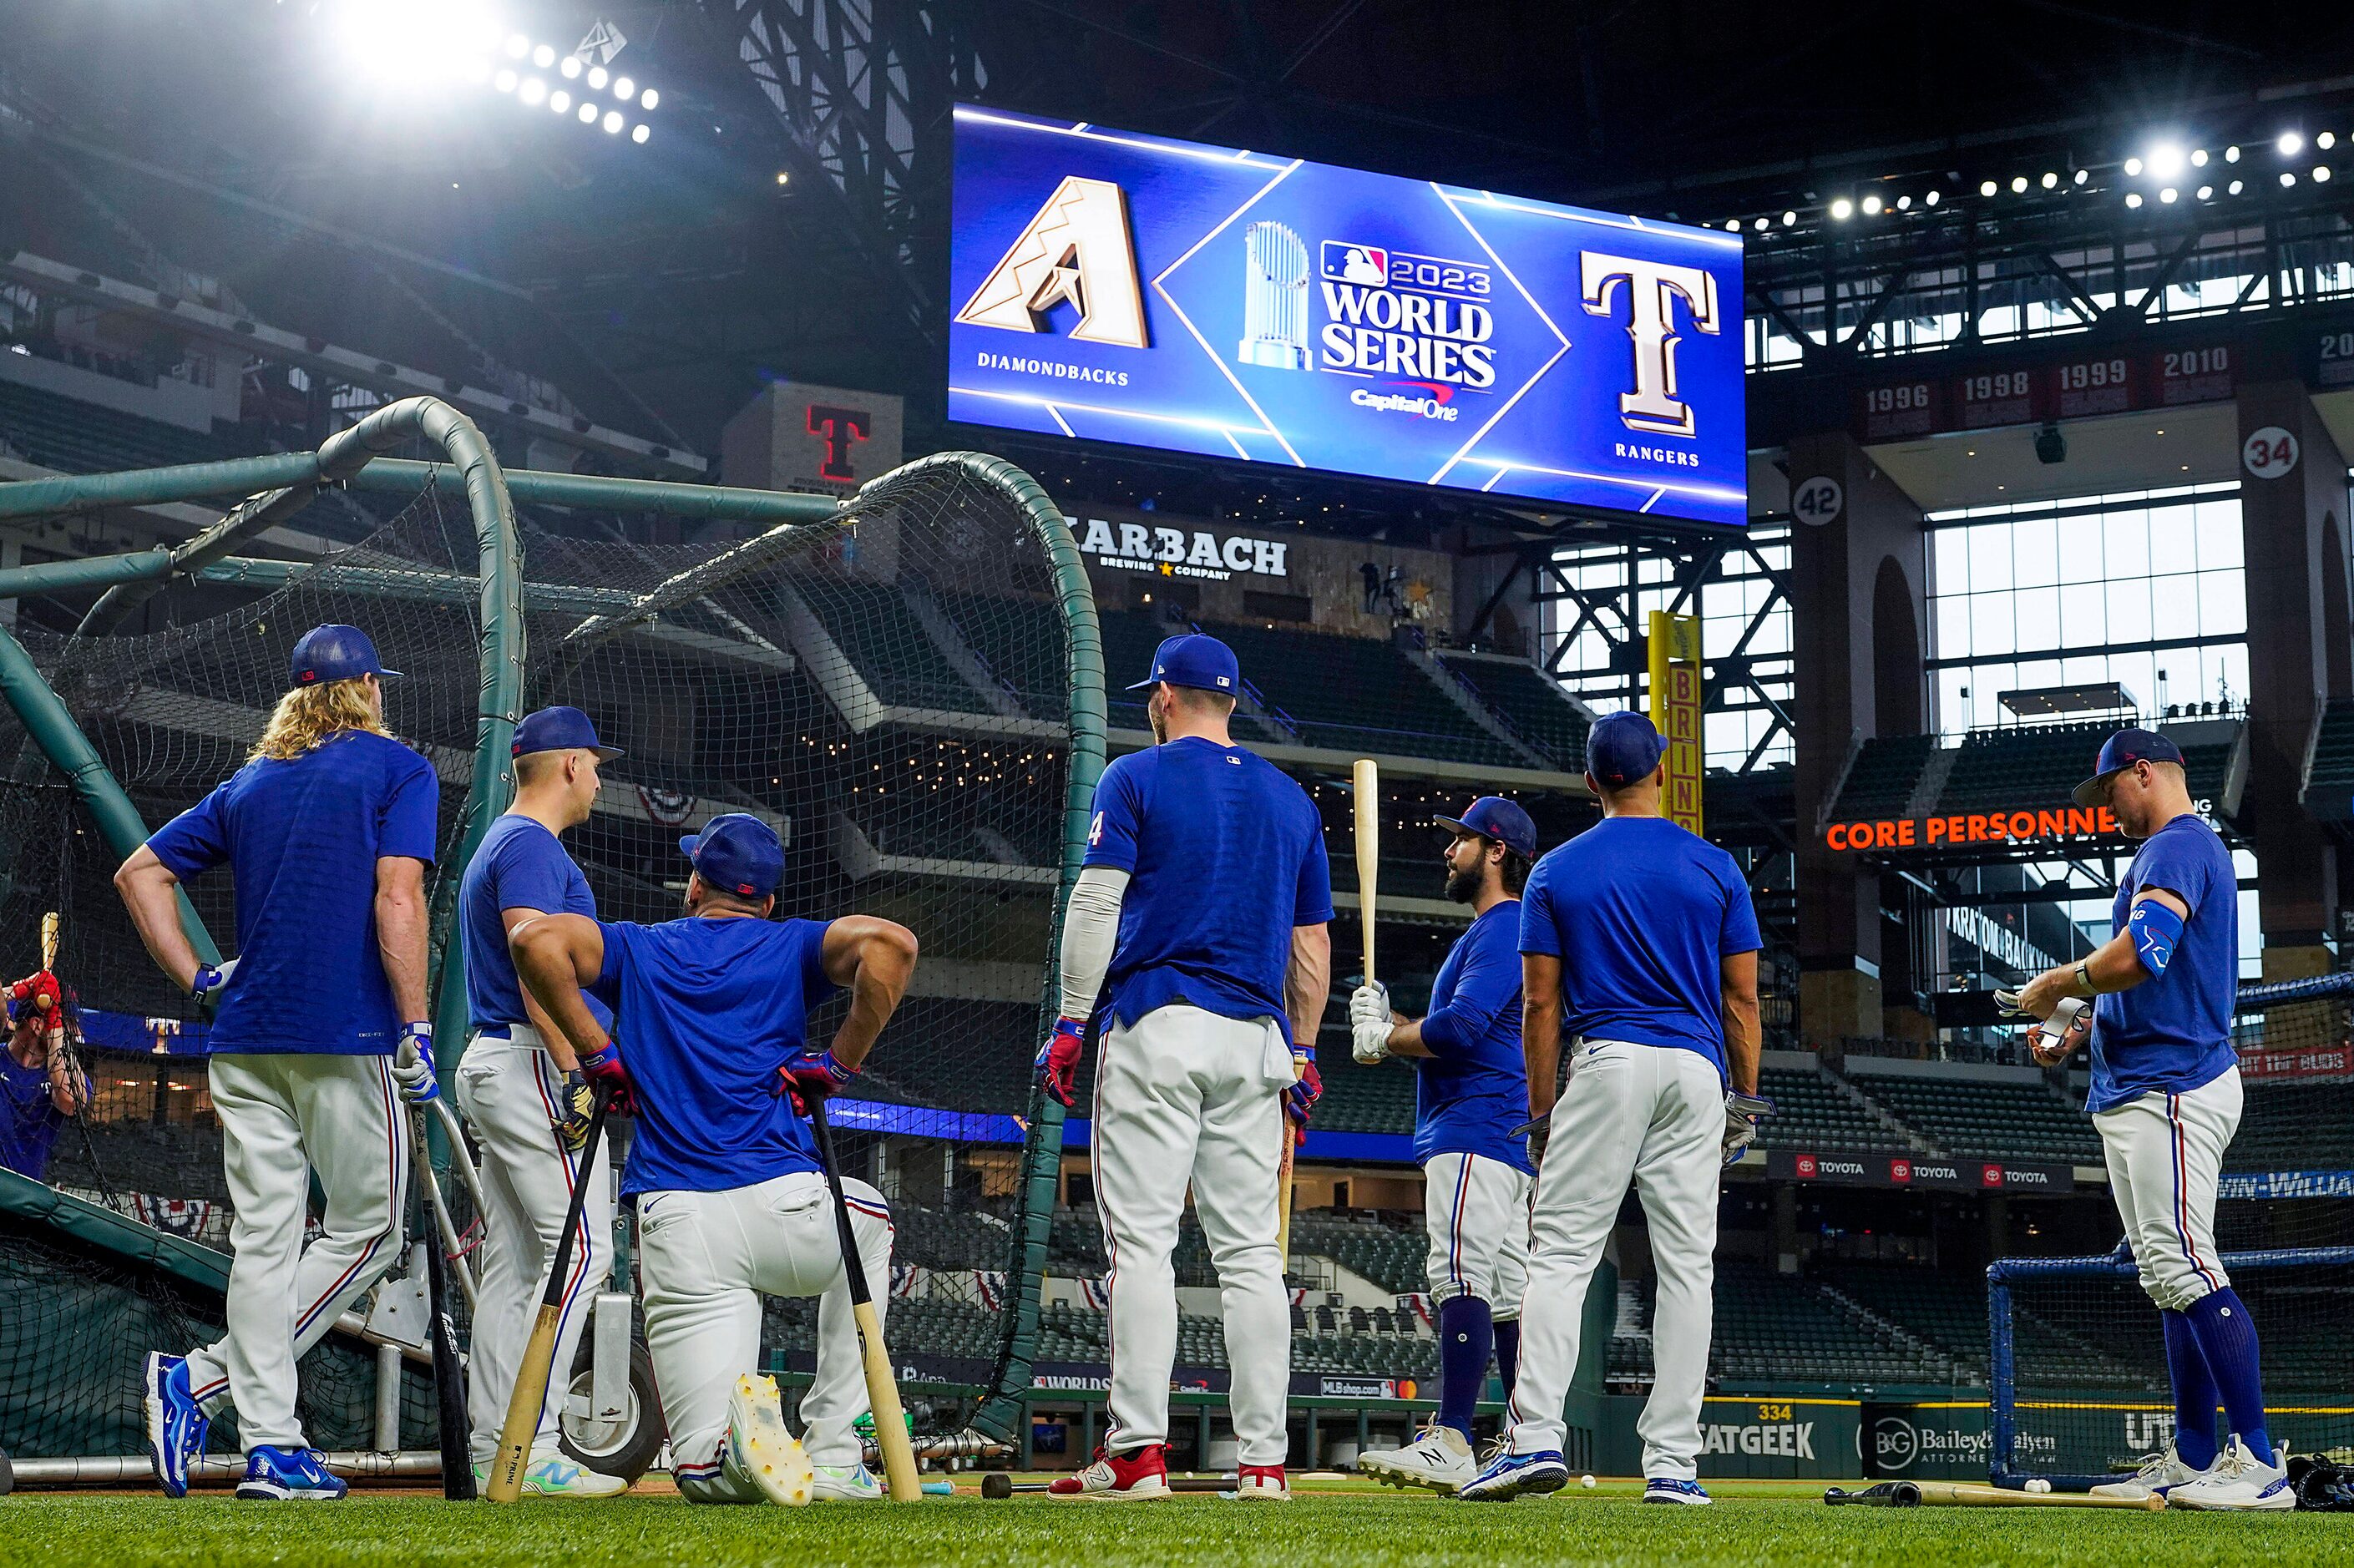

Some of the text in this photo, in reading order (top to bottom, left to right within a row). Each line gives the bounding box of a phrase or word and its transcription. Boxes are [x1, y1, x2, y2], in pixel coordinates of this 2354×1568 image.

[1391, 260, 1491, 295] 2023
[1319, 281, 1494, 343] WORLD
[1321, 324, 1496, 388] SERIES
[2320, 332, 2354, 359] 20
[977, 352, 1129, 387] DIAMONDBACKS
[2060, 359, 2126, 390] 1999
[2163, 346, 2229, 377] 2010
[1866, 384, 1929, 412] 1996
[1965, 371, 2029, 402] 1998
[1615, 442, 1700, 468] RANGERS
[2250, 435, 2294, 468] 34
[1799, 485, 1836, 516] 42
[1100, 556, 1155, 572] BREWING
[1174, 565, 1232, 581] COMPANY
[1826, 806, 2117, 851] CORE PERSONNE
[1819, 1161, 1865, 1175] TOYOTA
[1913, 1166, 1957, 1179] TOYOTA
[2005, 1171, 2048, 1184] TOYOTA
[442, 1319, 457, 1354] marucci
[1048, 1376, 1100, 1390] WORLD
[1759, 1404, 1792, 1421] 334
[1698, 1421, 1815, 1461] ATGEEK
[505, 1461, 518, 1485] PRIME
[1921, 1454, 1987, 1464] ATTORNE
